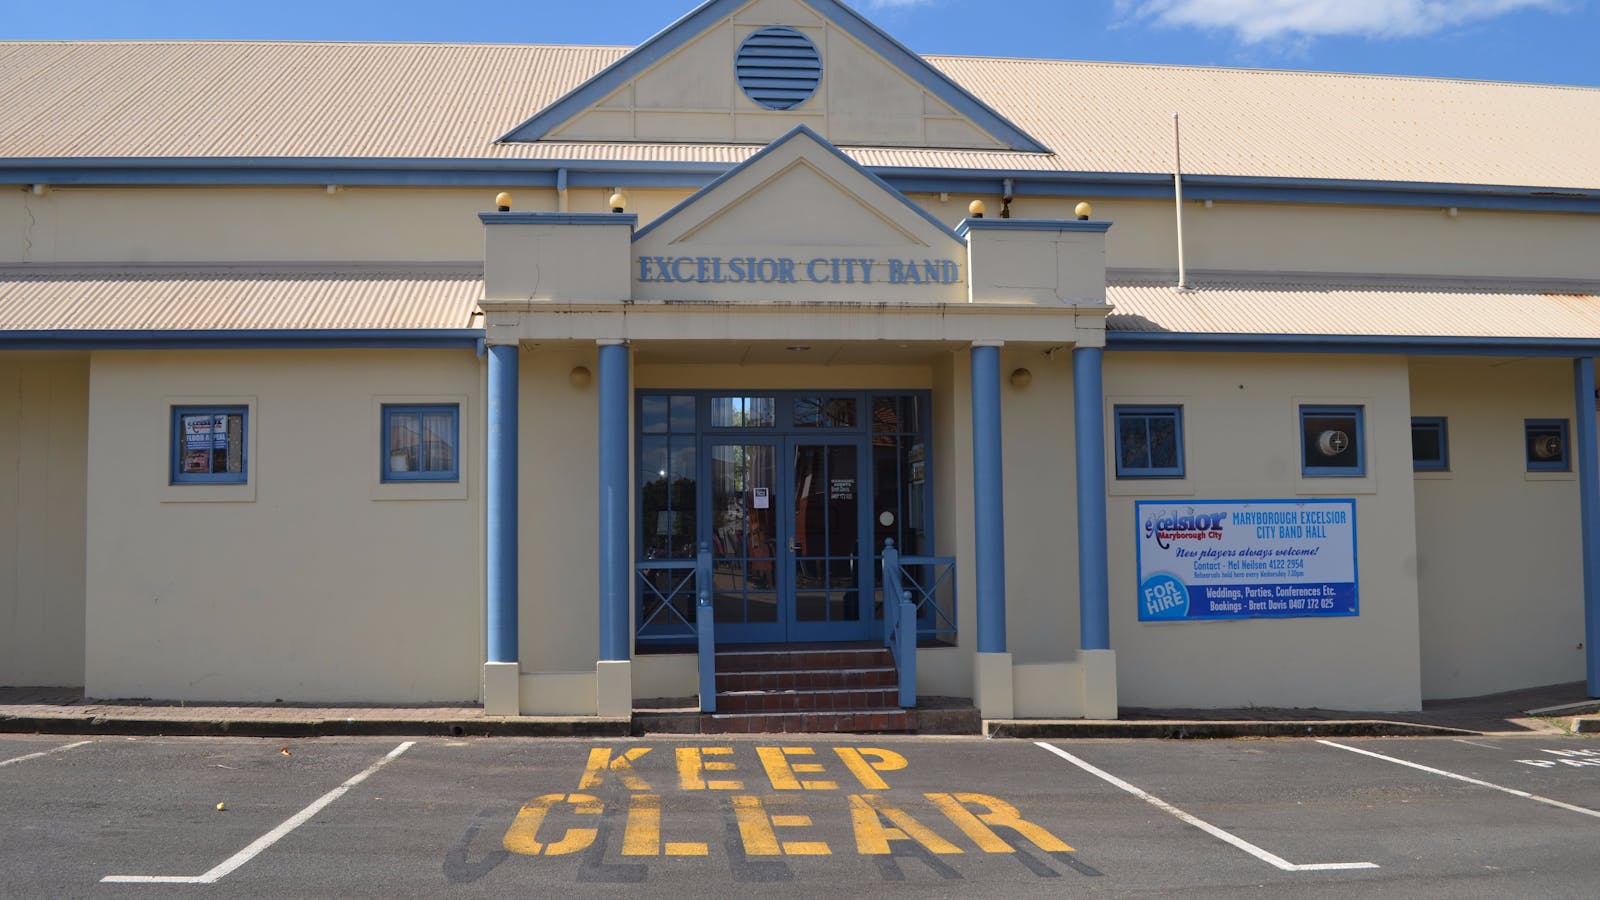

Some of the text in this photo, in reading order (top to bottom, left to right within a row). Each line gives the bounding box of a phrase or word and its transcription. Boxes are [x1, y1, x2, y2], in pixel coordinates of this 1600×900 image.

[638, 256, 960, 284] EXCELSIOR CITY BAND
[1232, 511, 1347, 525] MARYBOROUGH EXCELSIOR
[1158, 531, 1223, 541] Maryborough City
[1256, 525, 1327, 539] CITY BAND HALL
[1175, 546, 1320, 560] New players always welcome!
[1193, 560, 1221, 571] Contact
[1228, 560, 1240, 570] Mel
[1269, 559, 1285, 569] 4122
[1286, 559, 1304, 569] 2954
[1144, 580, 1178, 602] FOR
[1206, 584, 1337, 600] Weddings, Parties, Conferences Etc.
[1146, 591, 1185, 615] HIRE
[1210, 600, 1242, 613] Bookings
[1248, 600, 1267, 611] Brett
[1268, 599, 1287, 610] Davis
[1288, 598, 1306, 609] 0407
[1307, 598, 1320, 609] 172
[1320, 598, 1335, 609] 025
[578, 747, 909, 790] KEEP
[502, 792, 1076, 856] CLEAR
